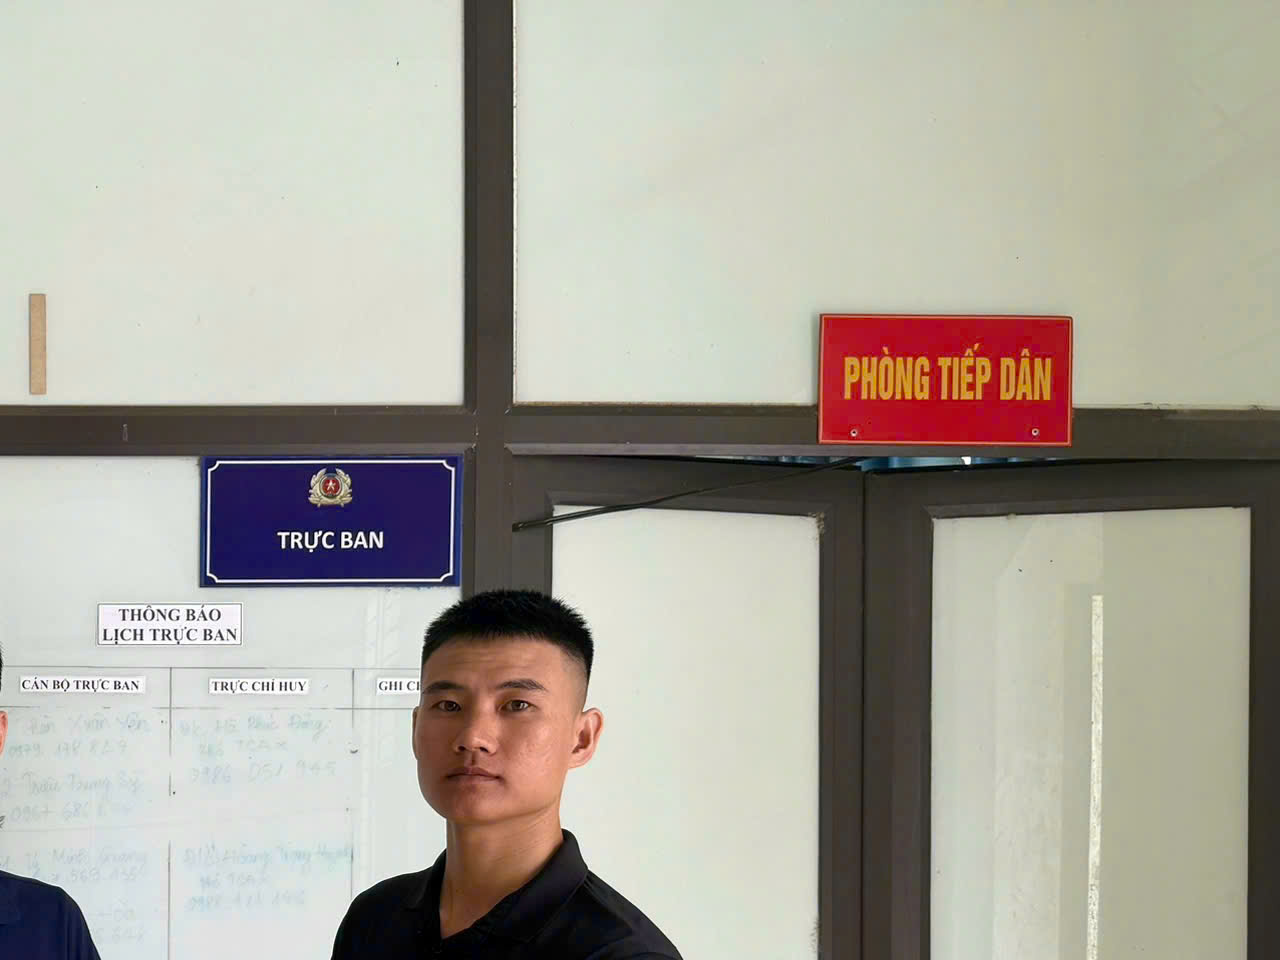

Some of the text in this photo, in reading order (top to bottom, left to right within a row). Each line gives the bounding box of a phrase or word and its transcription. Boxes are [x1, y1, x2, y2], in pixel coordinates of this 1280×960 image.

[843, 342, 1052, 401] PHÒNG TIẾP DÂN
[276, 530, 384, 553] TRỰC BAN
[118, 604, 222, 622] THÔNG BÁO
[102, 626, 238, 645] LỊCH TRỰC BAN
[21, 676, 140, 692] CÁN BỘ TRỰC BAN
[211, 679, 249, 693] TRỰC
[279, 681, 307, 691] HUY
[378, 680, 403, 691] GHI
